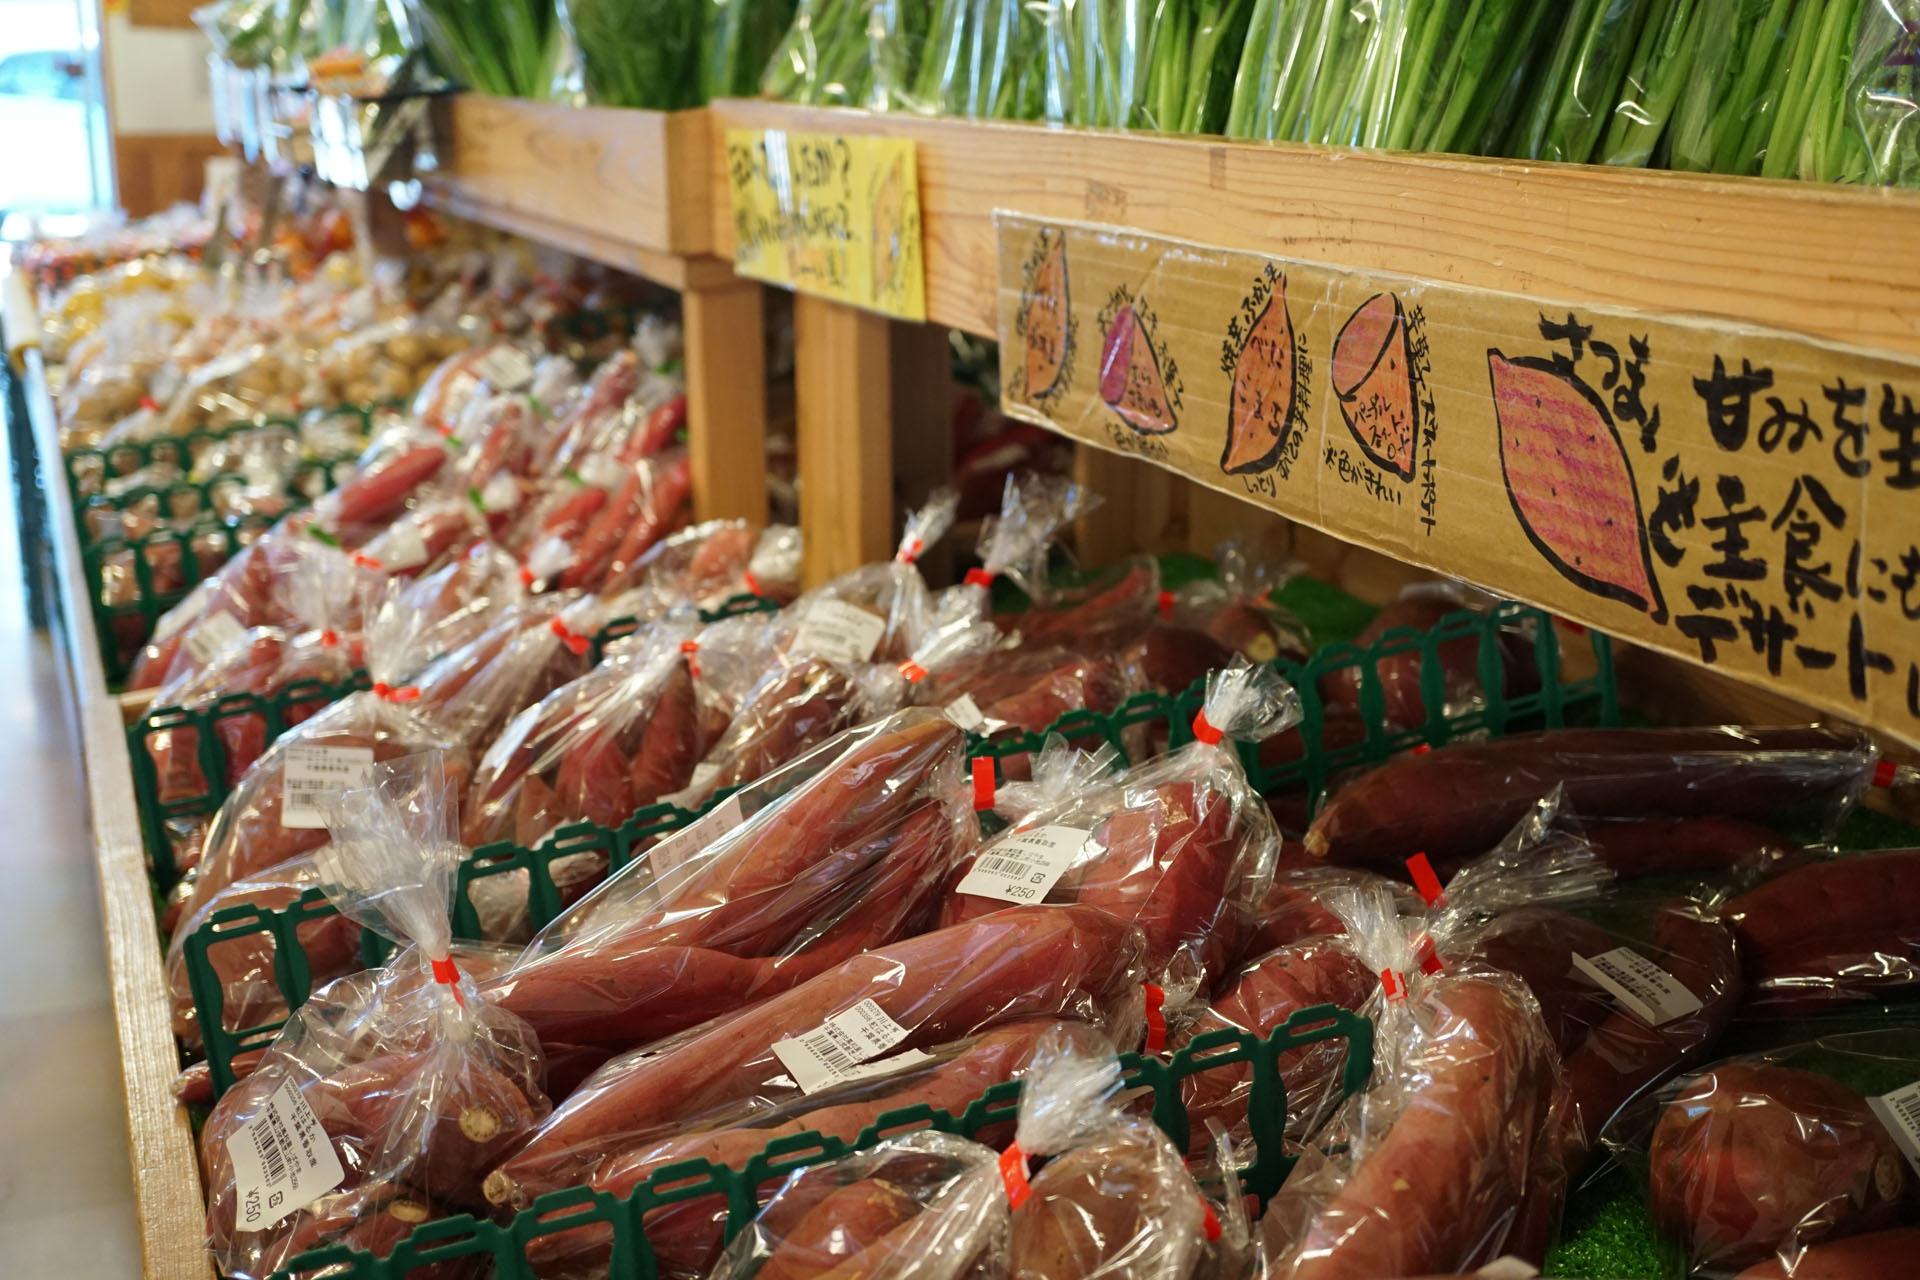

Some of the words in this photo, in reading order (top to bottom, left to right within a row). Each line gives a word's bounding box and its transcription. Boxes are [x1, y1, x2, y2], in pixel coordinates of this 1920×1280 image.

[1674, 584, 1920, 720] デザート
[1005, 884, 1036, 900] ¥250
[244, 1185, 261, 1223] ¥250
